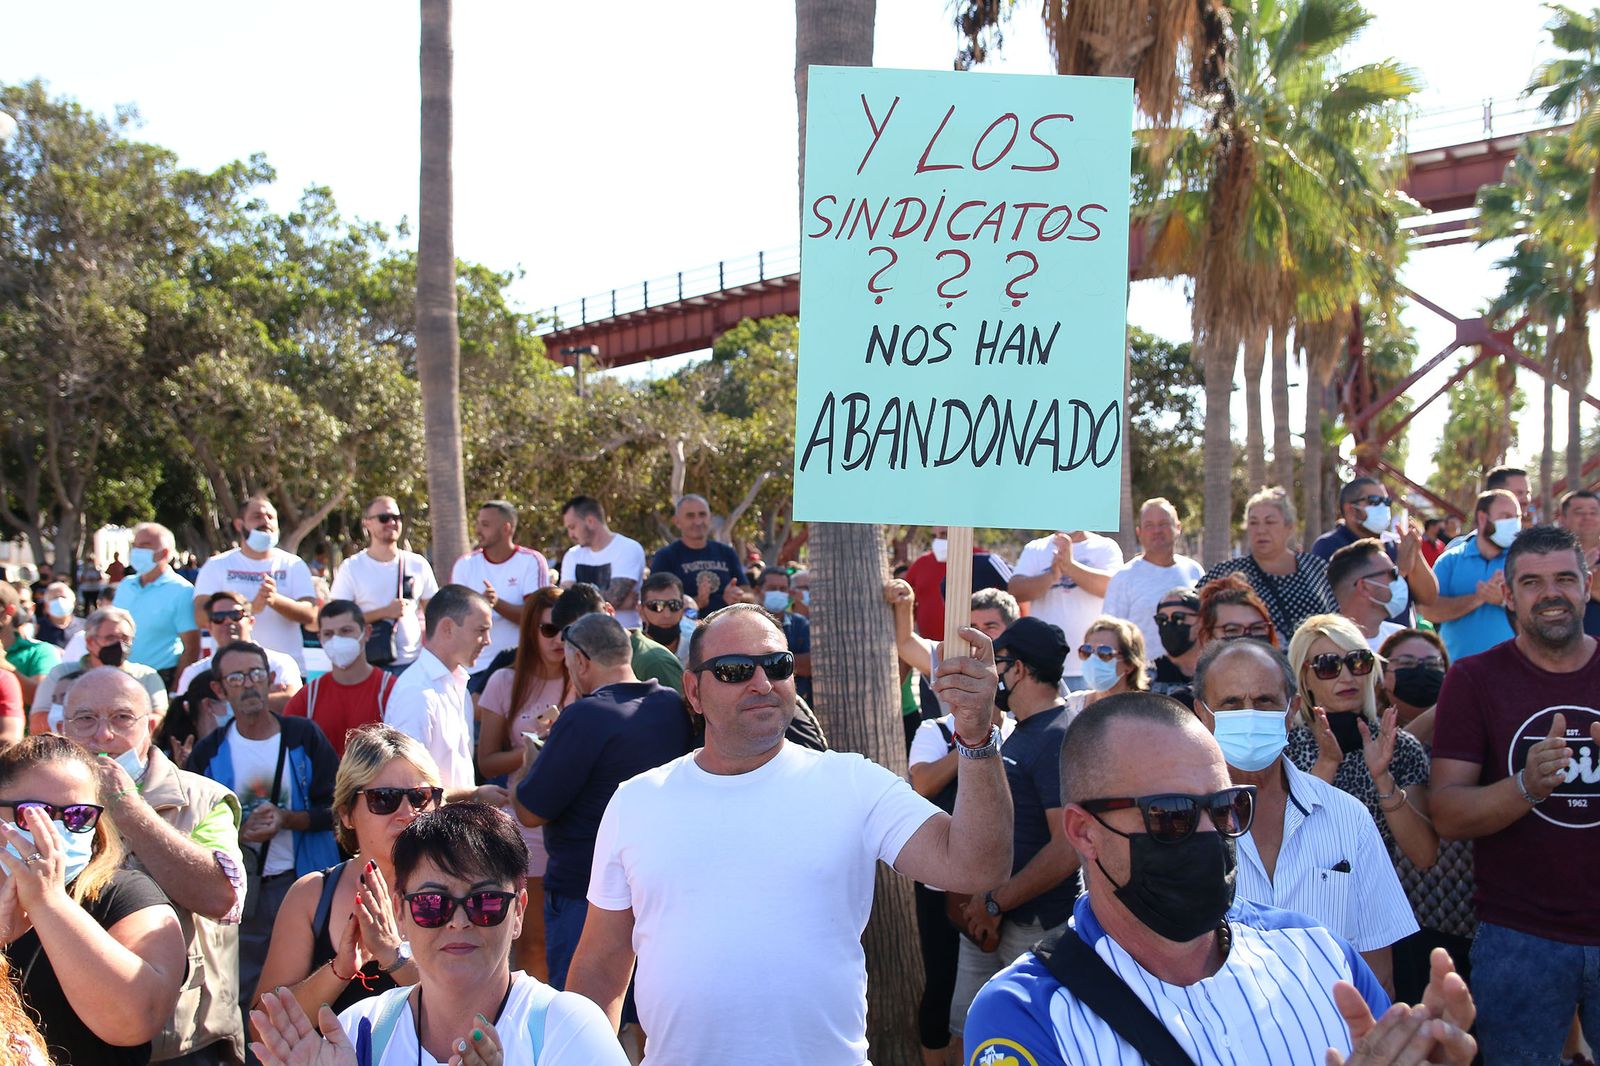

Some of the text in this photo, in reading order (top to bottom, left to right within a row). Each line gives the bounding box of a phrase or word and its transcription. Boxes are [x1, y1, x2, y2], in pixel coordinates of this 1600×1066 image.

[857, 93, 1074, 175] Y LOS
[809, 189, 1108, 243] SINDICATOS
[867, 246, 1039, 308] ? ? ?
[865, 320, 1061, 366] NOS HAN
[800, 390, 1121, 474] ABANDONADO
[681, 560, 729, 573] PORTUGAL
[1567, 799, 1588, 808] 1962
